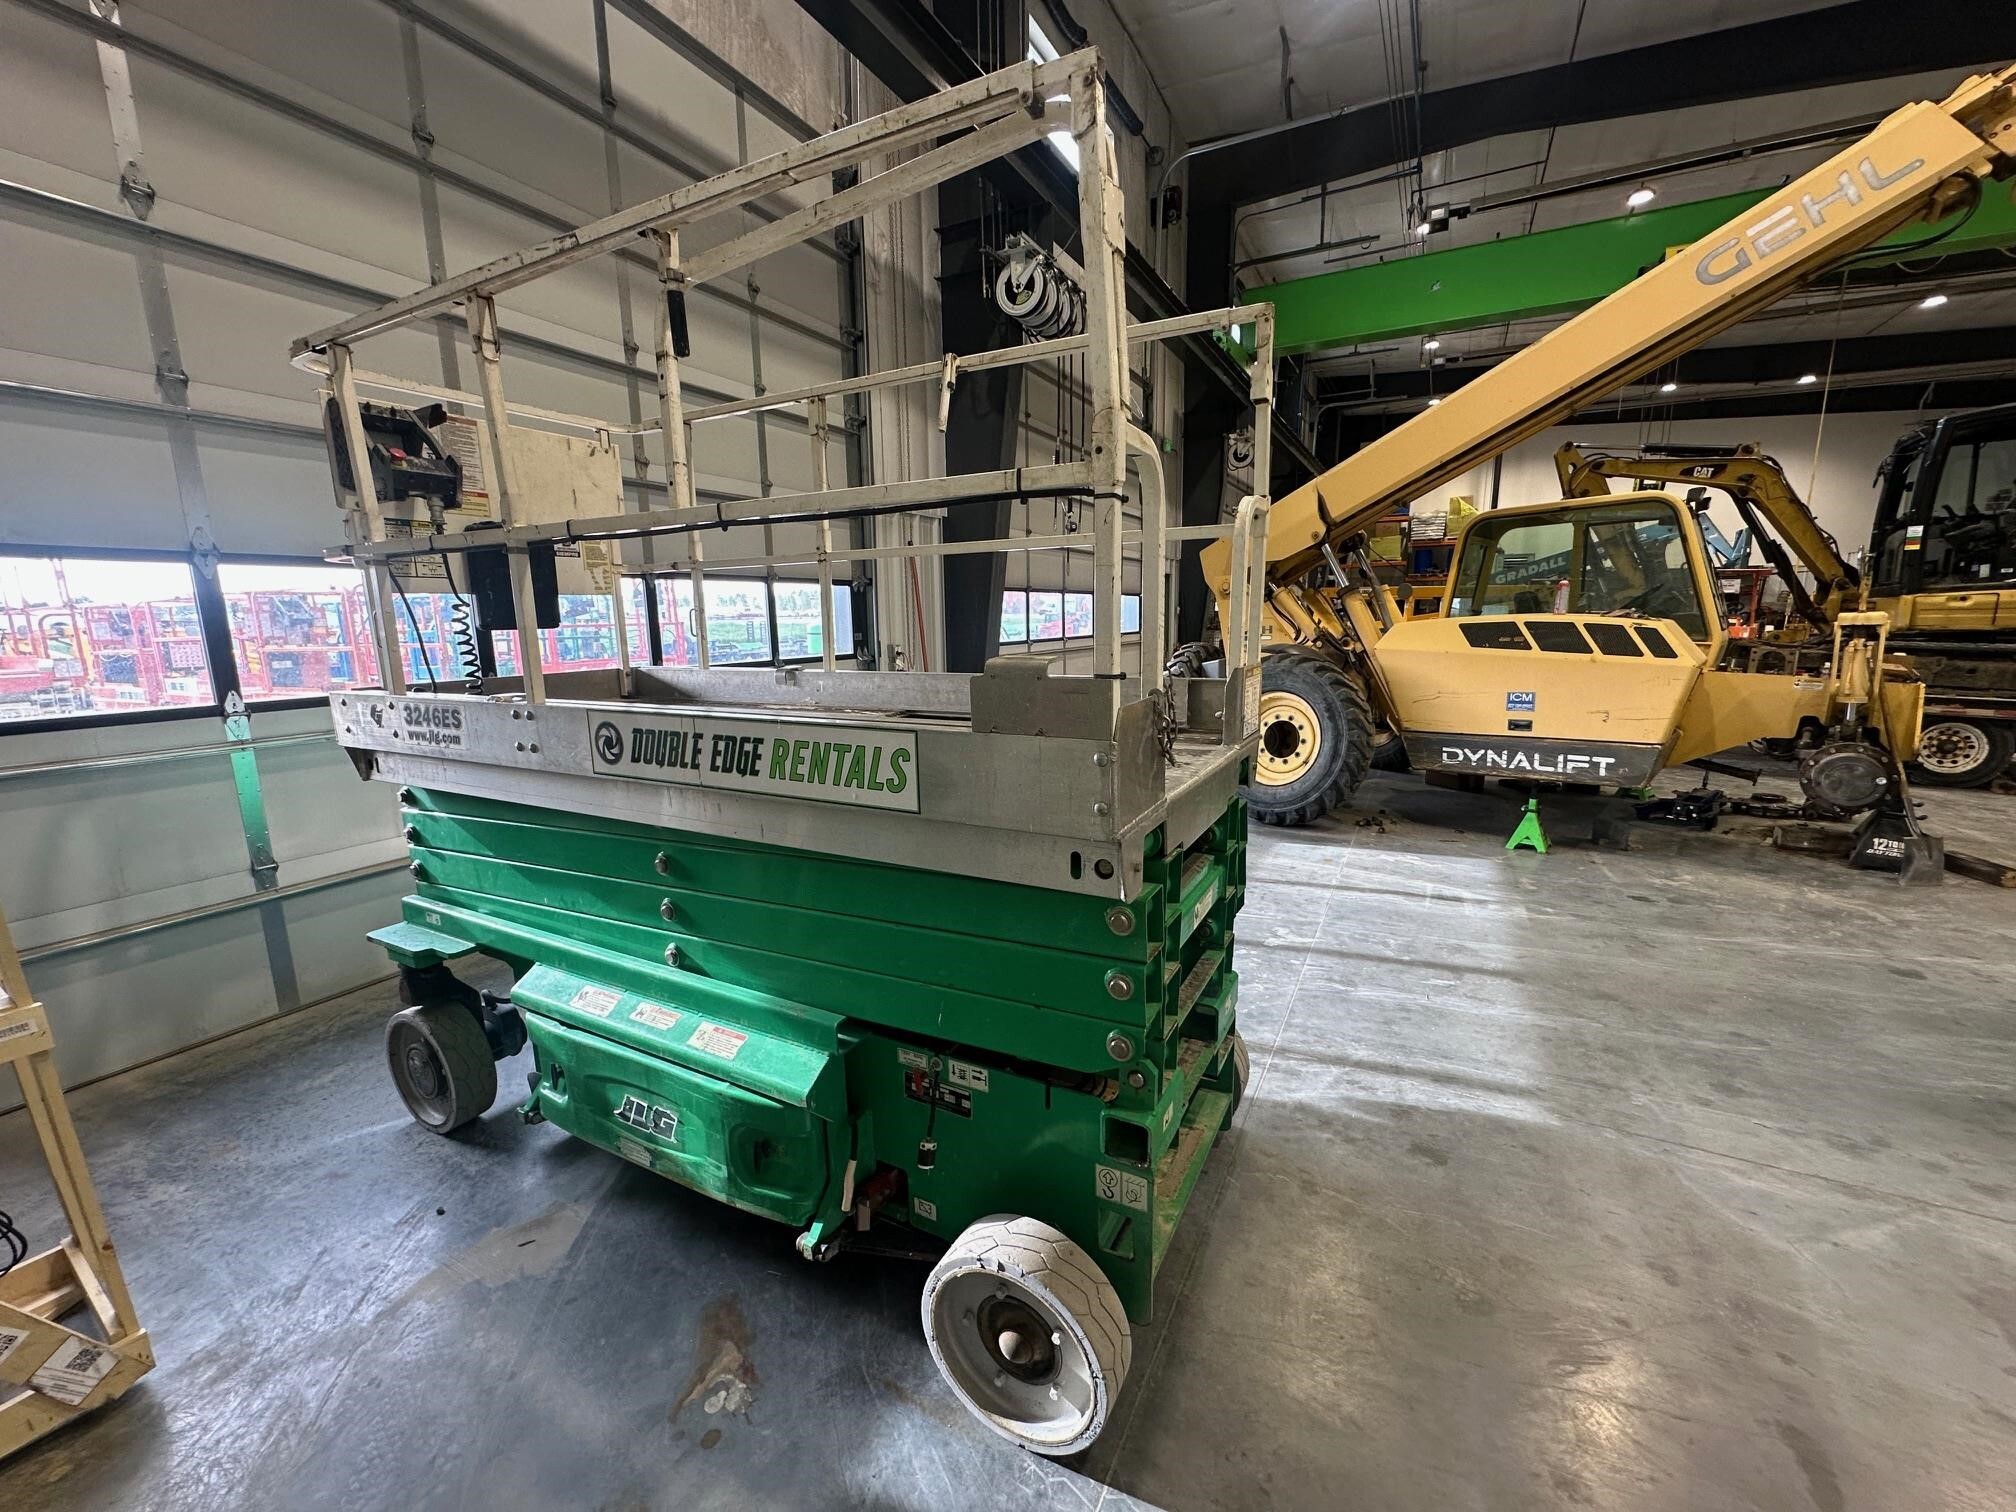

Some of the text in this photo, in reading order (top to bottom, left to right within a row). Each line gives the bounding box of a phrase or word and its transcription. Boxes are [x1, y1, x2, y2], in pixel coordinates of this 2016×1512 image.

[1696, 156, 1925, 286] GEHL
[1693, 466, 1714, 478] CAT
[1495, 557, 1567, 584] GRADALL
[1509, 692, 1533, 702] ICM
[403, 703, 463, 729] 3246ES
[407, 729, 462, 746] www.jlg.com
[630, 727, 912, 794] DOUBLE EDGE RENTALS
[1441, 747, 1616, 777] DYNALIFT
[613, 1093, 678, 1143] JLG
